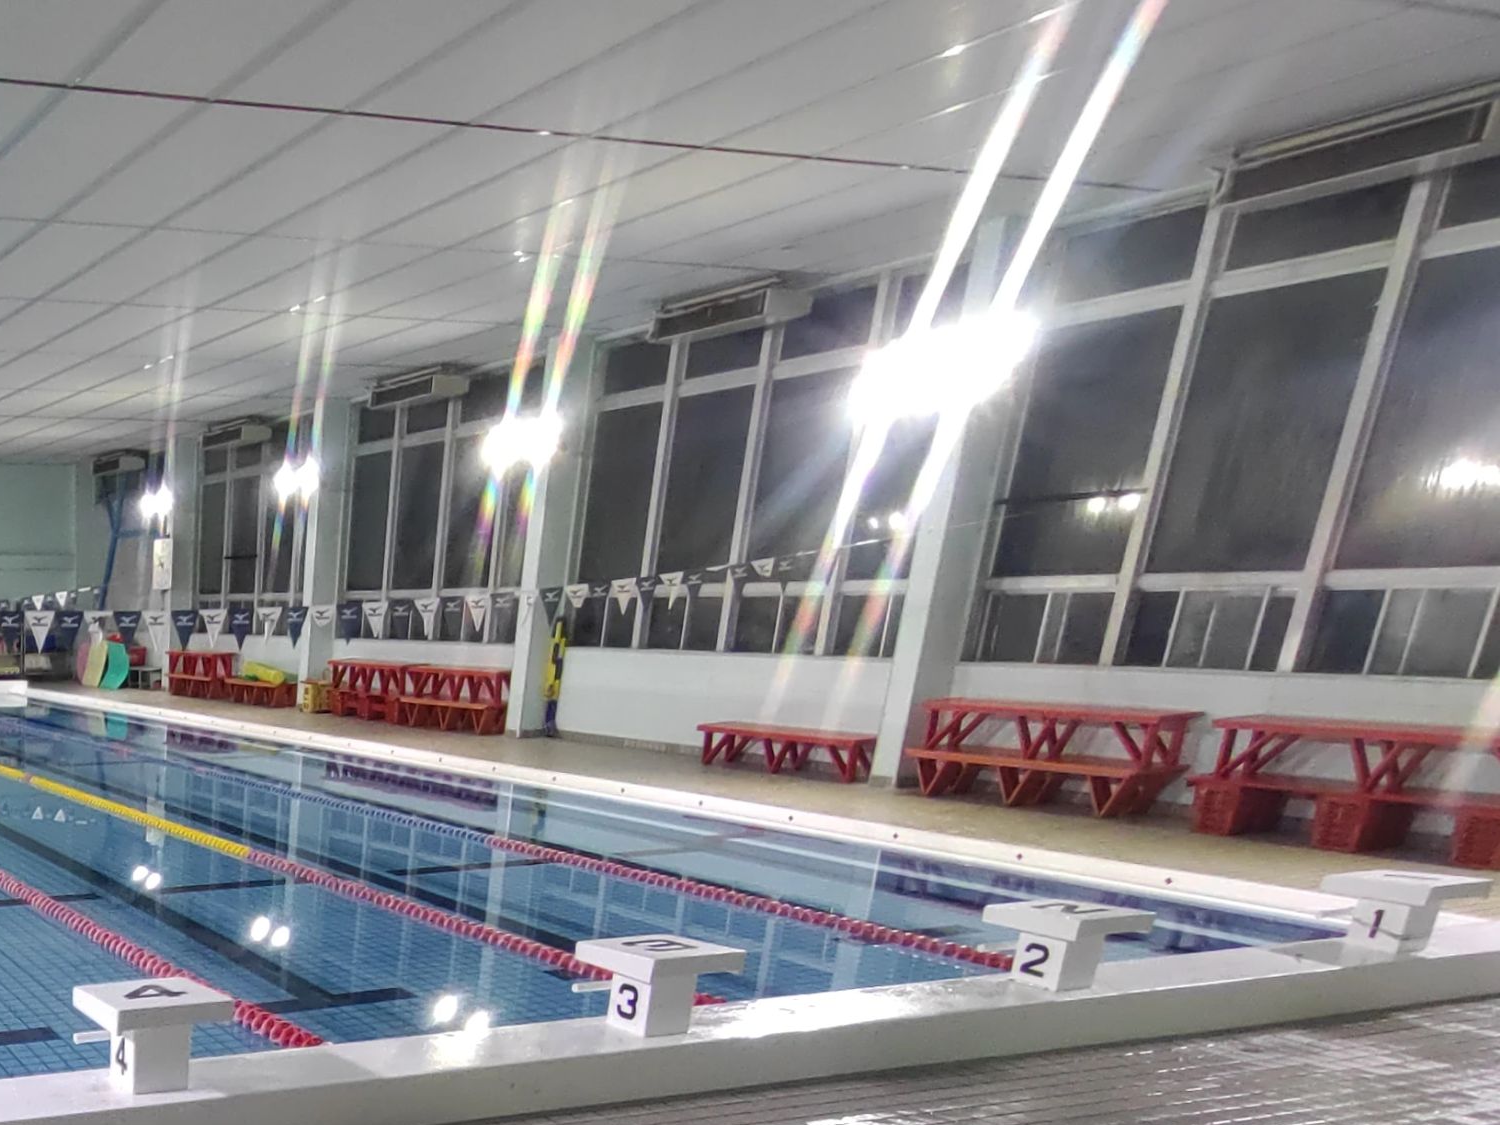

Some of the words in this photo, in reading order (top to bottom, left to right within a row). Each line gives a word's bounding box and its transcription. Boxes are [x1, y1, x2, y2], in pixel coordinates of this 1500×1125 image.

[1368, 909, 1385, 938] 1
[1019, 942, 1050, 978] 2
[123, 983, 188, 1000] 4
[616, 982, 639, 1021] 3
[115, 1036, 128, 1076] 4
